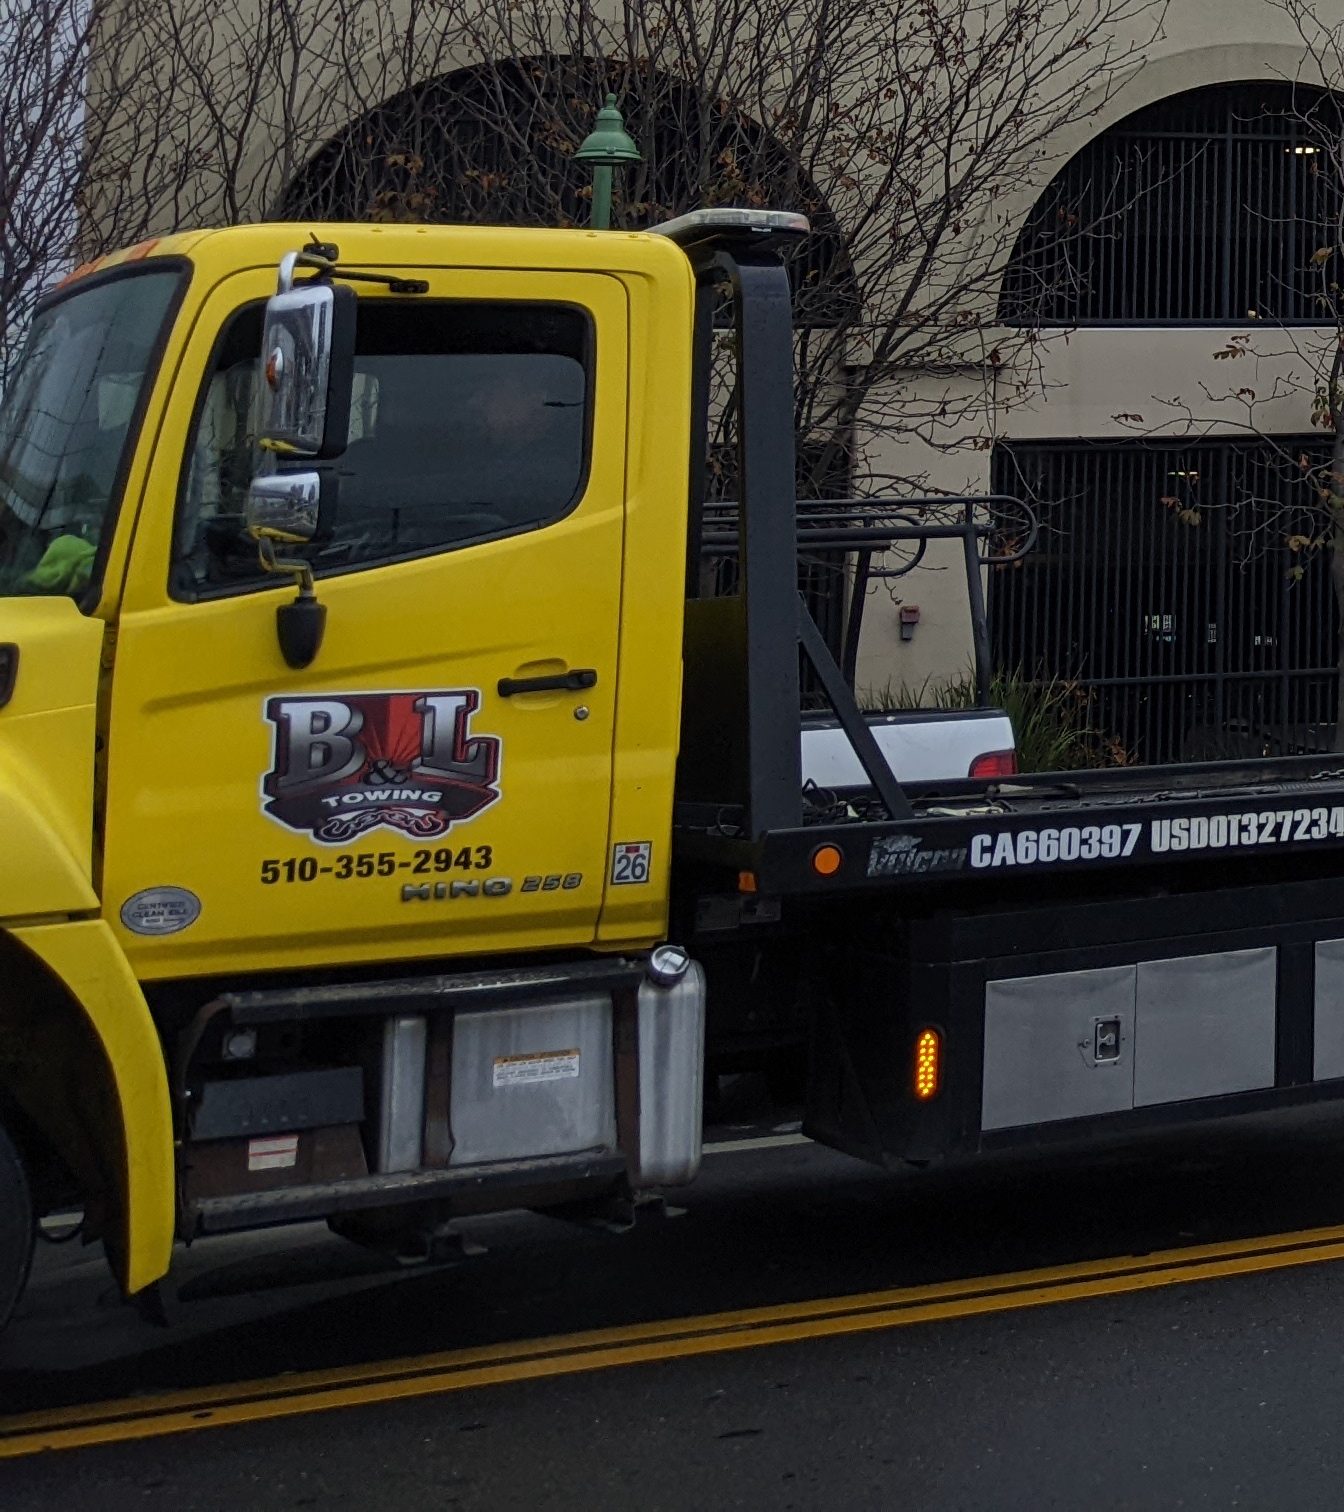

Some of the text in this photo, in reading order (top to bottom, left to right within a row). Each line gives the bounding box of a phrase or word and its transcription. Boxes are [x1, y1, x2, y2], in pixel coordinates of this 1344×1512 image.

[279, 695, 490, 789] B & L
[321, 789, 443, 808] TOWING
[970, 823, 1143, 869] CA660397
[260, 845, 493, 884] 510-355-2943
[615, 853, 647, 880] 26
[402, 872, 583, 901] HINO 258
